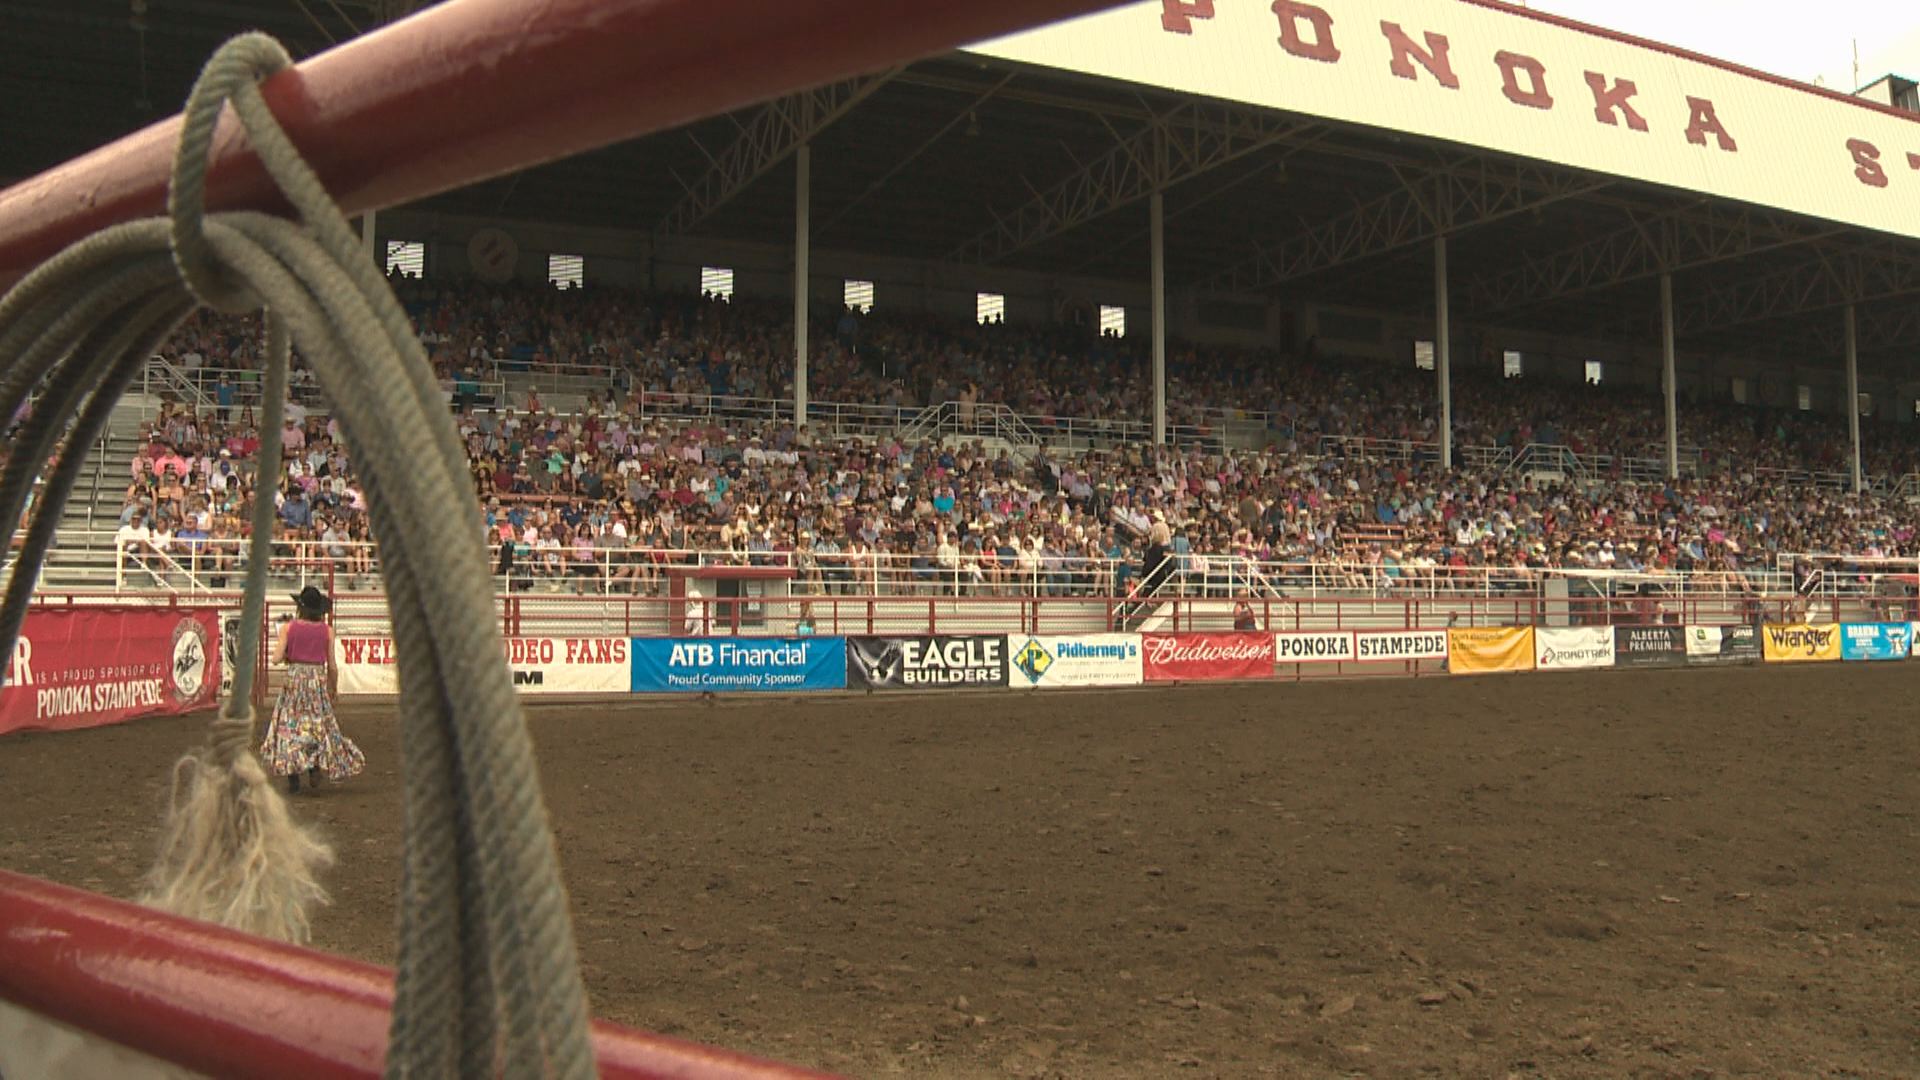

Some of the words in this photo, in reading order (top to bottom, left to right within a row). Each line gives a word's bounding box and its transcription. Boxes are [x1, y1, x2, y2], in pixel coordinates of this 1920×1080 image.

[1846, 138, 1920, 187] S
[1280, 637, 1350, 656] PONOKA
[1360, 635, 1444, 656] STAMPEDE
[1629, 640, 1672, 652] PREMIUM
[1630, 629, 1670, 641] ALBERTA
[1769, 627, 1832, 656] Wrangler
[341, 639, 398, 664] WEL
[504, 639, 553, 664] DEO
[565, 638, 626, 664] FANS
[668, 643, 714, 667] ATB
[719, 642, 806, 667] Financial
[903, 639, 1001, 668] EAGLE
[1057, 641, 1137, 660] Pidherney's
[1143, 637, 1272, 664] Budweiser
[36, 671, 47, 685] IS
[52, 670, 58, 683] A
[63, 668, 95, 681] PROUD
[100, 664, 146, 679] SPONSOR
[150, 663, 161, 675] OF
[668, 673, 700, 685] Proud
[702, 673, 761, 686] Community
[764, 672, 806, 686] Sponsor
[903, 668, 1001, 684] BUILDERS
[37, 685, 92, 719] PONOKA
[94, 678, 164, 711] STAMPEDE
